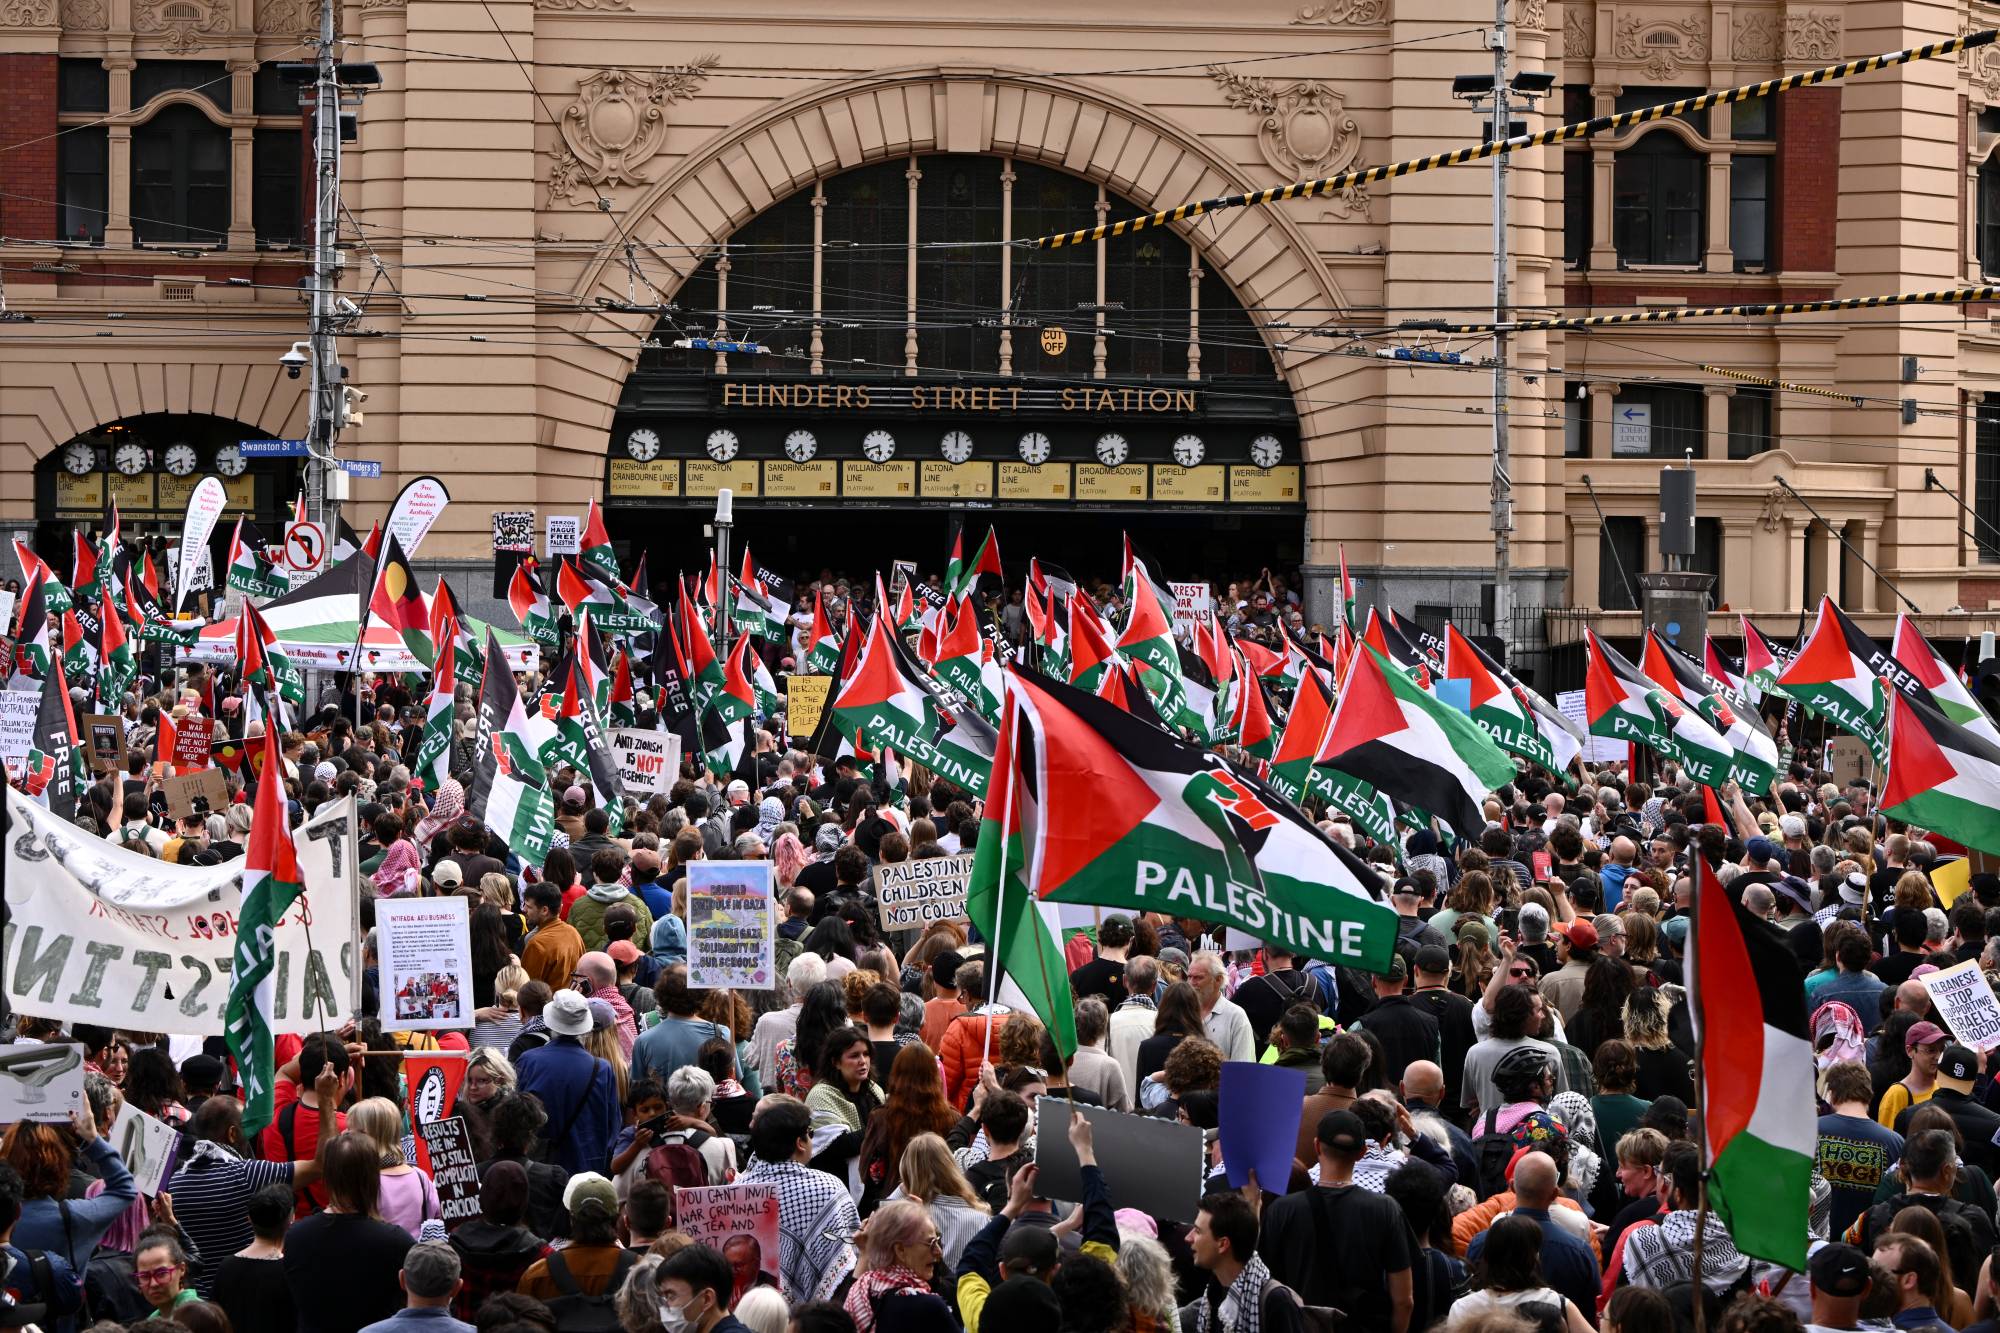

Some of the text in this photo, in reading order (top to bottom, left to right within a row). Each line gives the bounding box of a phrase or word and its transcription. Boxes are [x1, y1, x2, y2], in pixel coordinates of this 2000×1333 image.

[1043, 330, 1062, 339] CUT
[1044, 342, 1063, 351] OFF
[723, 383, 1195, 412] FLINDERS STREET STATION
[241, 442, 280, 451] Swanston
[282, 441, 290, 451] St
[346, 461, 379, 472] Flinders St
[612, 462, 663, 472] PAKENHAM and
[687, 463, 732, 472] FRANKSTON
[767, 463, 822, 472] SANDRINGHAM
[847, 463, 903, 472] WILLIAMSTOWN
[925, 464, 954, 472] ALTONA
[1012, 466, 1042, 474] ALBANS
[1079, 467, 1142, 476] BROADMEADOWS
[1157, 468, 1187, 476] UPFIELD
[612, 472, 678, 482] CRANBOURNE LINES
[687, 473, 704, 481] LINE
[767, 473, 783, 482] LINE
[846, 474, 862, 482] LINE
[924, 474, 940, 482] LINE
[1234, 469, 1271, 477] WERRIBEE
[109, 476, 145, 484] BELGRAVE
[160, 476, 179, 484] GLEN
[1002, 476, 1018, 484] LINE
[1079, 477, 1095, 485] LINE
[1156, 478, 1173, 486] LINE
[1233, 479, 1250, 487] LINE
[496, 513, 530, 528] HERZOG
[499, 524, 529, 538] WAR
[495, 535, 531, 546] CRIMINAL
[756, 567, 784, 588] FREE
[915, 582, 946, 605] FREE
[75, 609, 99, 634] FREE
[983, 623, 1017, 658] FREE
[1869, 650, 1921, 697] FREE
[802, 676, 811, 684] IS
[665, 669, 689, 713] FREE
[790, 685, 827, 693] HERZOG
[1702, 673, 1747, 710] FREE
[803, 695, 820, 703] THE
[790, 705, 822, 714] EPSTEIN
[94, 726, 115, 735] WANTED
[188, 723, 203, 731] WAR
[177, 730, 211, 740] CRIMINALS
[179, 738, 207, 747] ARE NOT
[176, 745, 208, 754] WELCOME
[867, 713, 985, 791] PALESTINE
[50, 731, 71, 796] FREE
[625, 752, 664, 774] IS NOT
[882, 880, 964, 903] CHILDREN
[691, 898, 766, 910] SCHOOLS IN GAZA
[1134, 860, 1366, 958] PALESTINE
[429, 913, 456, 921] BUSINESS
[887, 907, 919, 924] NOT
[696, 927, 763, 939] REDOUBLE GAZA
[698, 942, 760, 953] SOLIDARITY IN
[699, 957, 759, 968] OUR SCHOOLS
[1930, 969, 1978, 994] ALBANESE
[1945, 987, 1973, 1007] STOP
[1942, 995, 1992, 1018] SUPPORTING
[1948, 1005, 1999, 1031] ISRAEL'S
[422, 1120, 460, 1141] RESULTS
[427, 1136, 457, 1152] ARE IN:
[431, 1149, 471, 1170] ALP STILL
[434, 1165, 476, 1188] COMPLICIT
[452, 1184, 464, 1198] IN
[680, 1185, 778, 1207] YOU CANT INVITE
[440, 1195, 483, 1220] GENOCIDE
[680, 1202, 771, 1225] WAR CRIMINALS
[704, 1220, 725, 1231] TEA
[730, 1219, 755, 1231] AND
